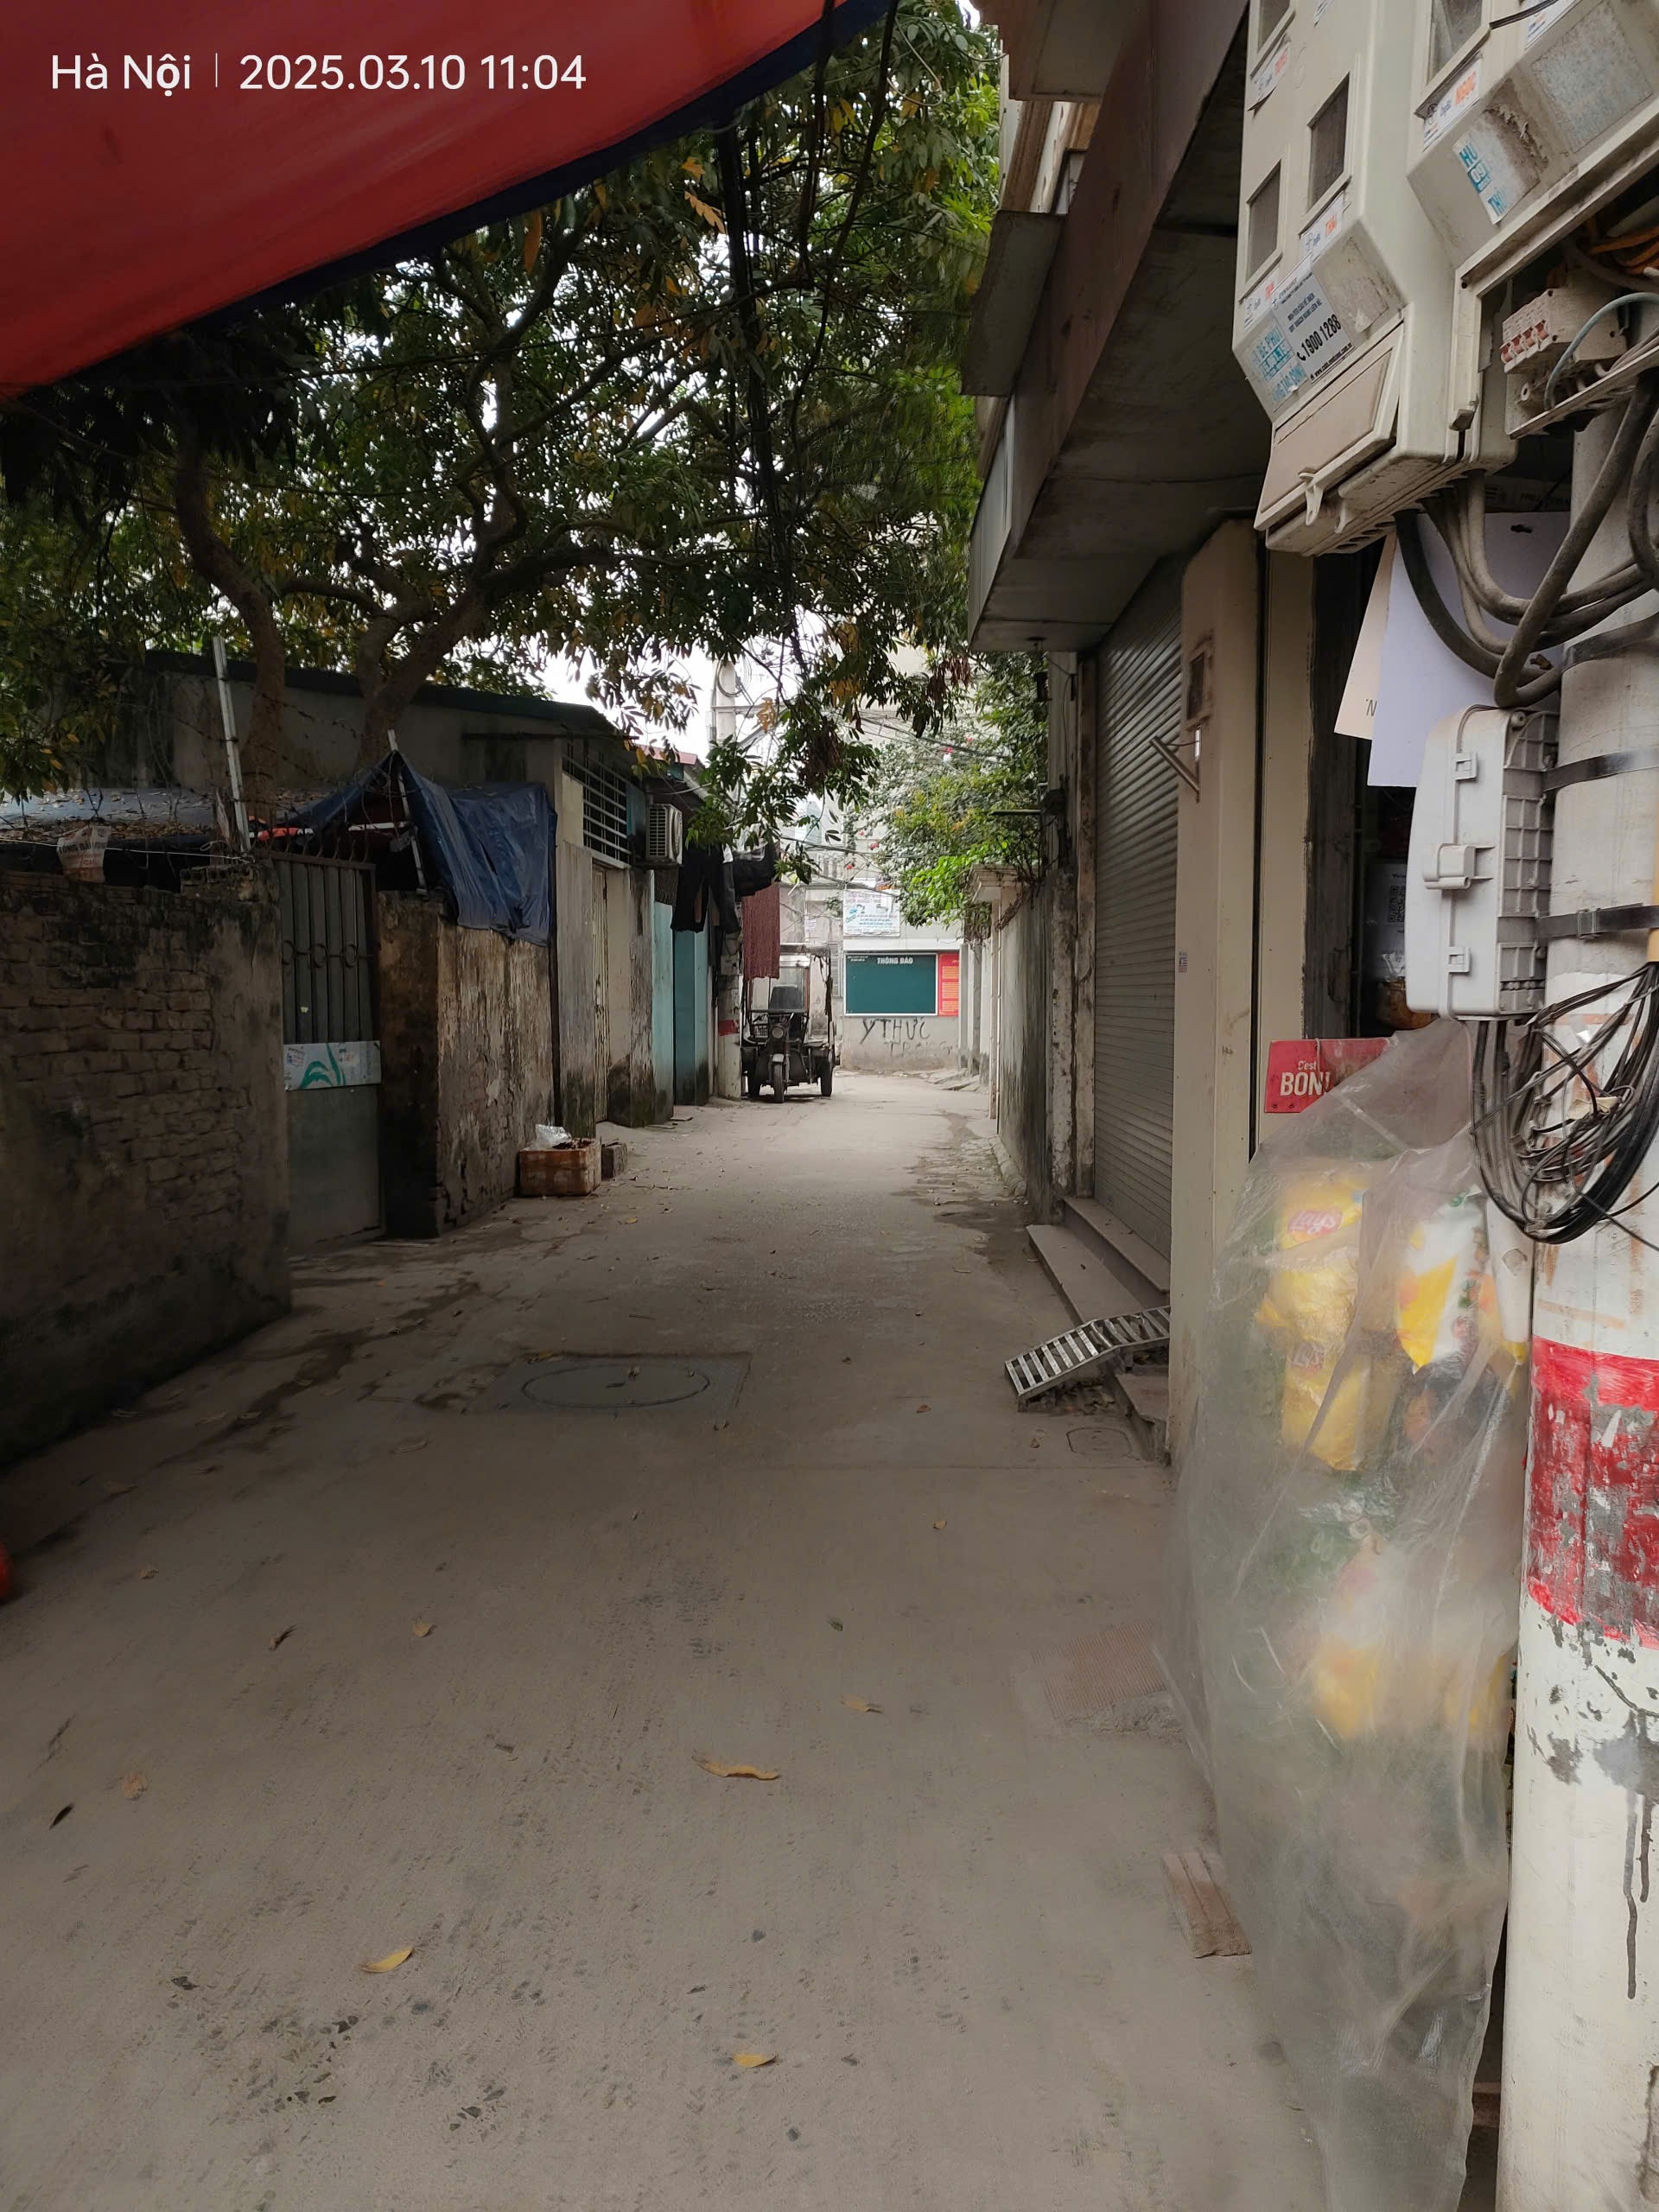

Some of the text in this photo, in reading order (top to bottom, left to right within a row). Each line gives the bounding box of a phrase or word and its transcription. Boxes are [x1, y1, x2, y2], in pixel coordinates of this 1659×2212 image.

[1301, 330, 1324, 358] 1900
[1319, 314, 1342, 342] 1288
[877, 957, 899, 965] THÔNG
[899, 956, 913, 965] BÁO
